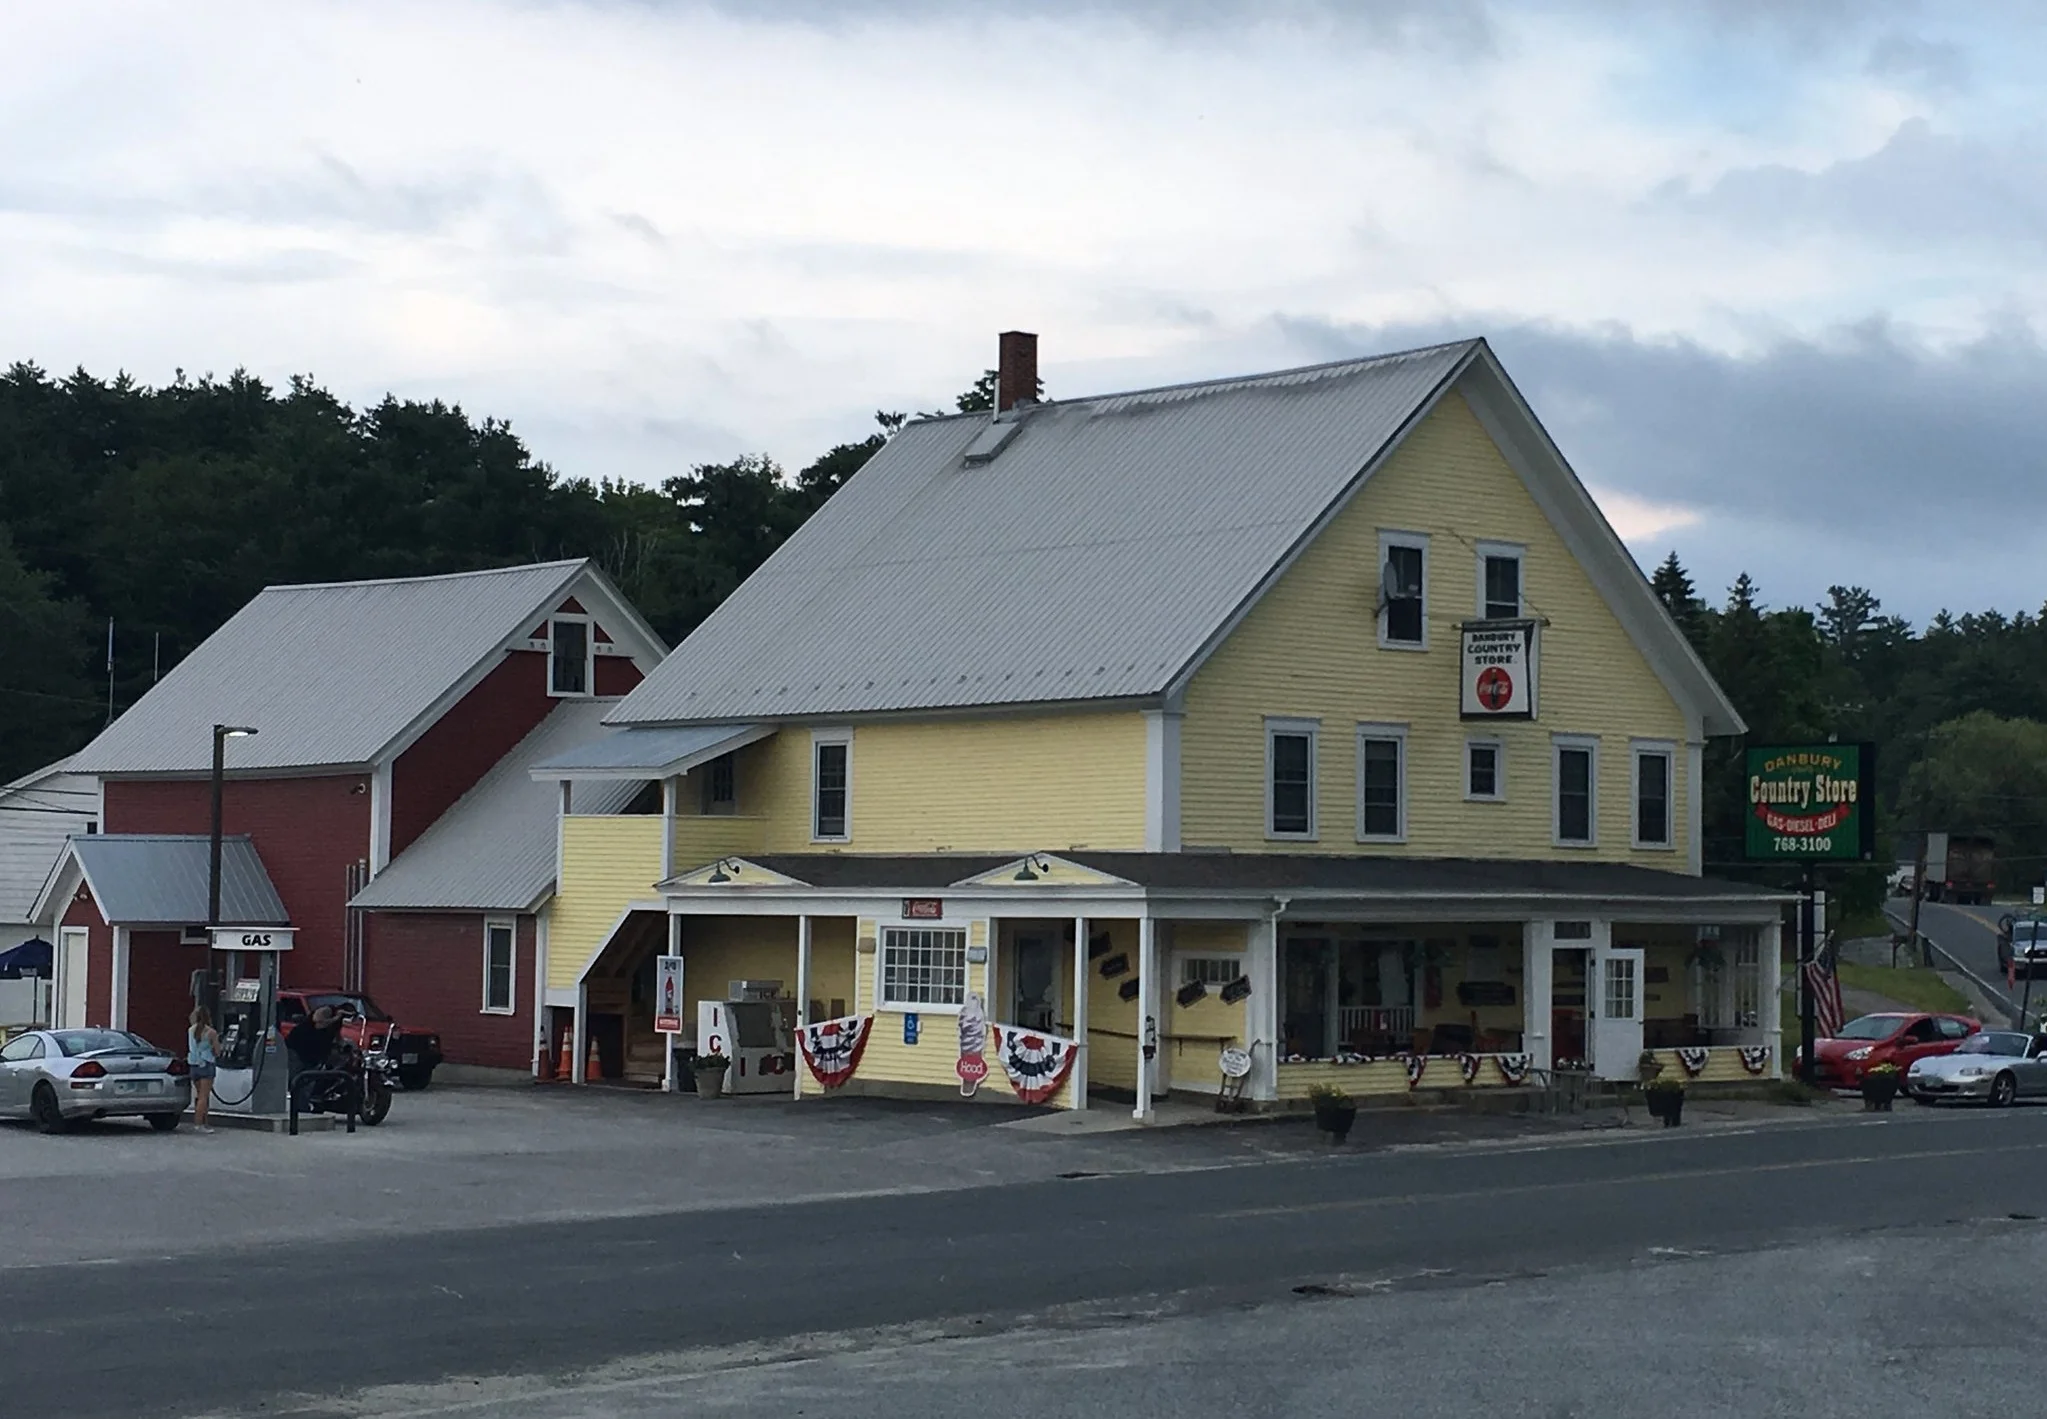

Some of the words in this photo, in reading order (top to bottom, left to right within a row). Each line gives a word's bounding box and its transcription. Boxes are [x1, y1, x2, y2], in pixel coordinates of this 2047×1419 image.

[1467, 644, 1521, 654] COUNTRY
[1475, 655, 1512, 664] STORE
[1764, 753, 1842, 772] DANBURY
[1750, 775, 1811, 809] Country
[1815, 774, 1857, 802] Store
[1773, 837, 1831, 851] 768-3100
[242, 934, 271, 946] GAS
[960, 1061, 984, 1075] Hood
